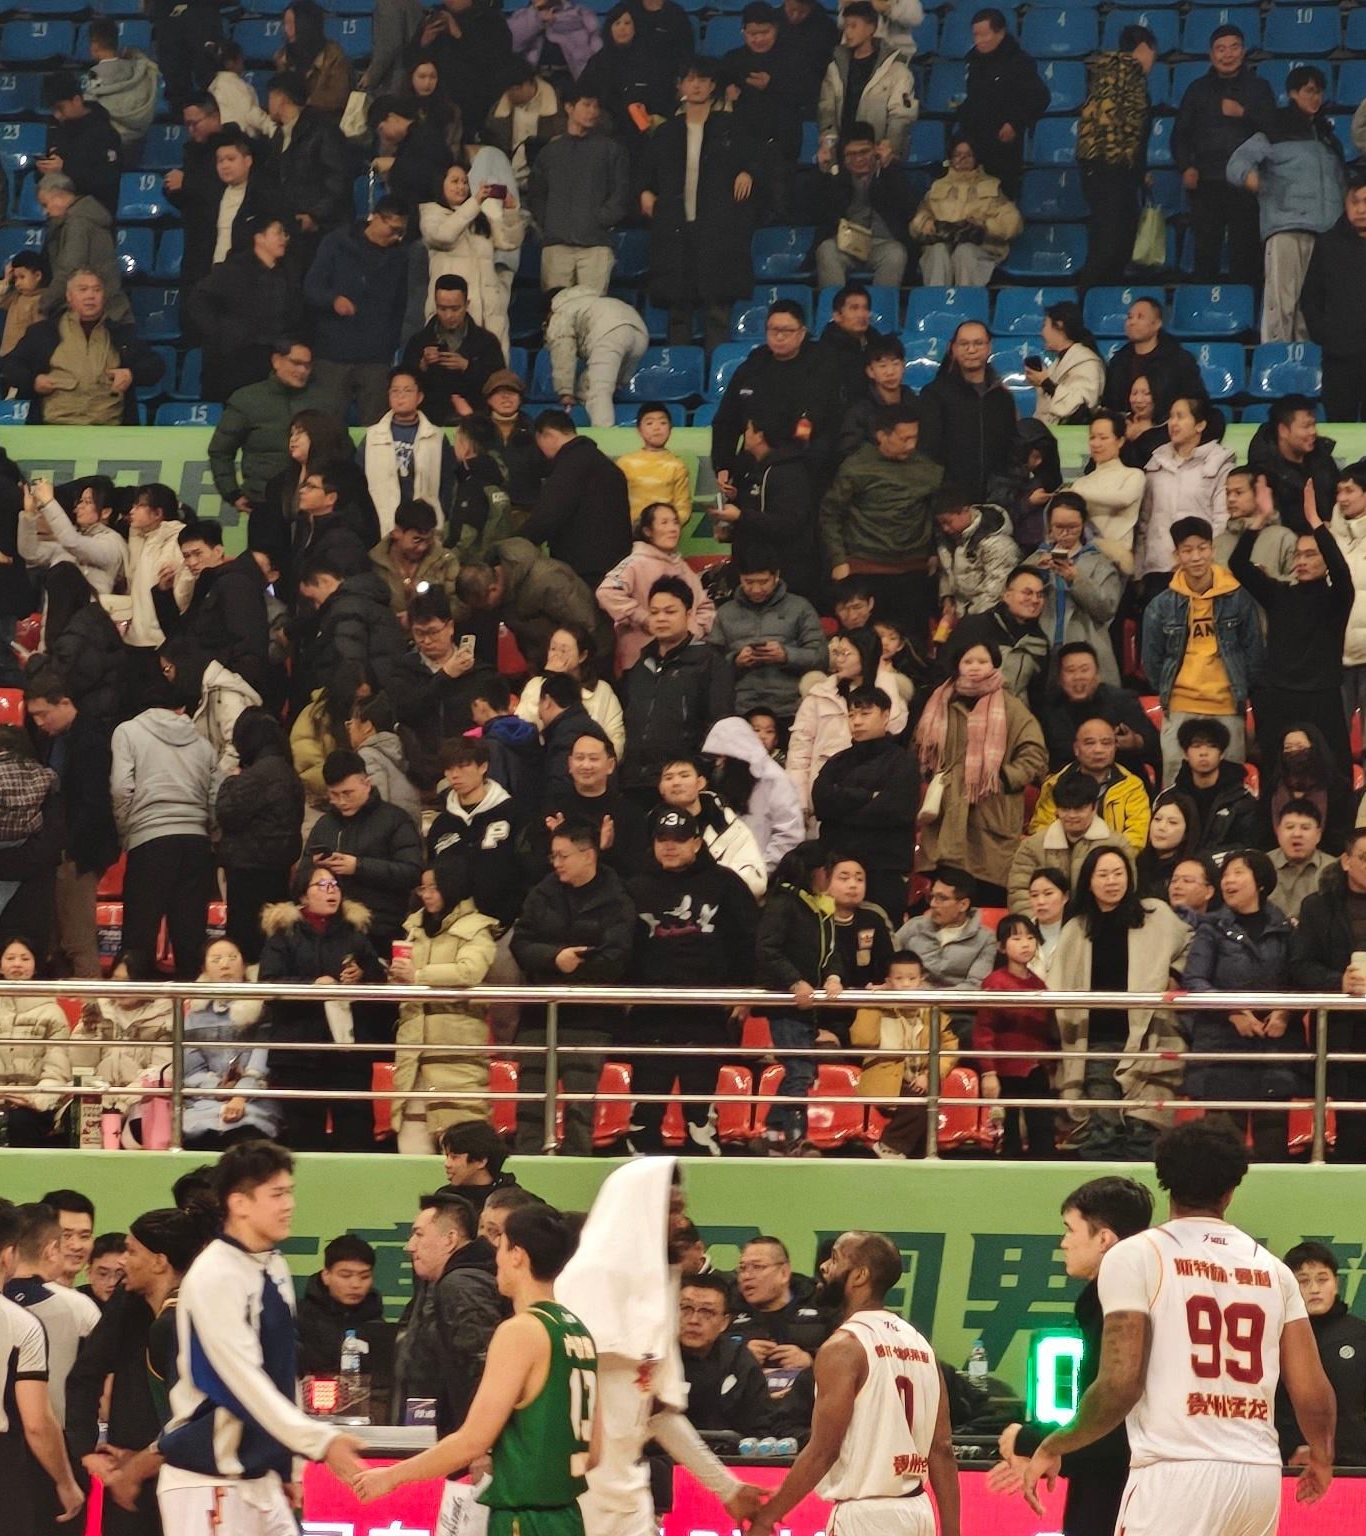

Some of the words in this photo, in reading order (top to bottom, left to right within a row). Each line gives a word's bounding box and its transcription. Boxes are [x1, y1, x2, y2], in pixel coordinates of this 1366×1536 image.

[946, 288, 955, 305] 2
[1286, 342, 1304, 362] 10
[1185, 1294, 1266, 1385] 99
